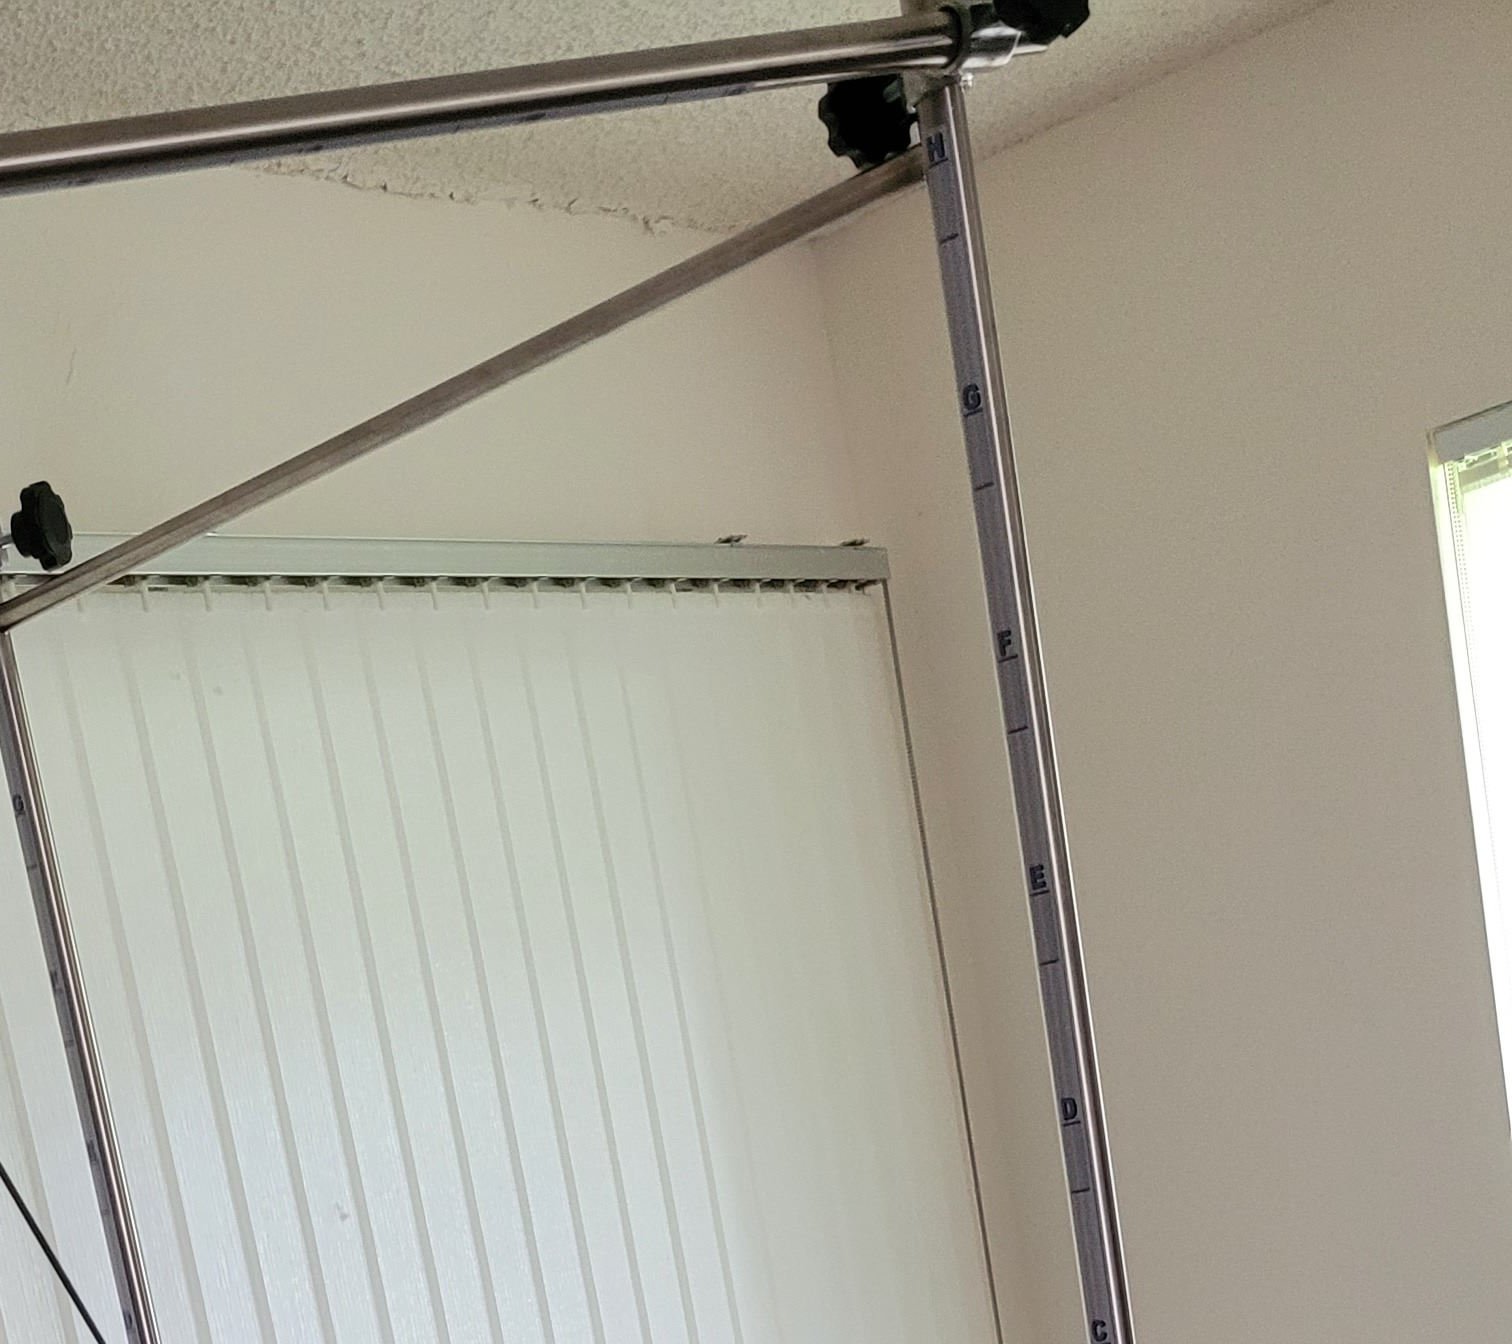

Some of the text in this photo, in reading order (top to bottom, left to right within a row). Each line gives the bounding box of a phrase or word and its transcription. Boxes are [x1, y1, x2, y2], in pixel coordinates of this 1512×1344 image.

[927, 132, 945, 162] H
[963, 384, 981, 410] G
[997, 630, 1011, 656] F
[1030, 864, 1046, 890] E
[1061, 1097, 1077, 1120] D
[1092, 1319, 1107, 1341] C
